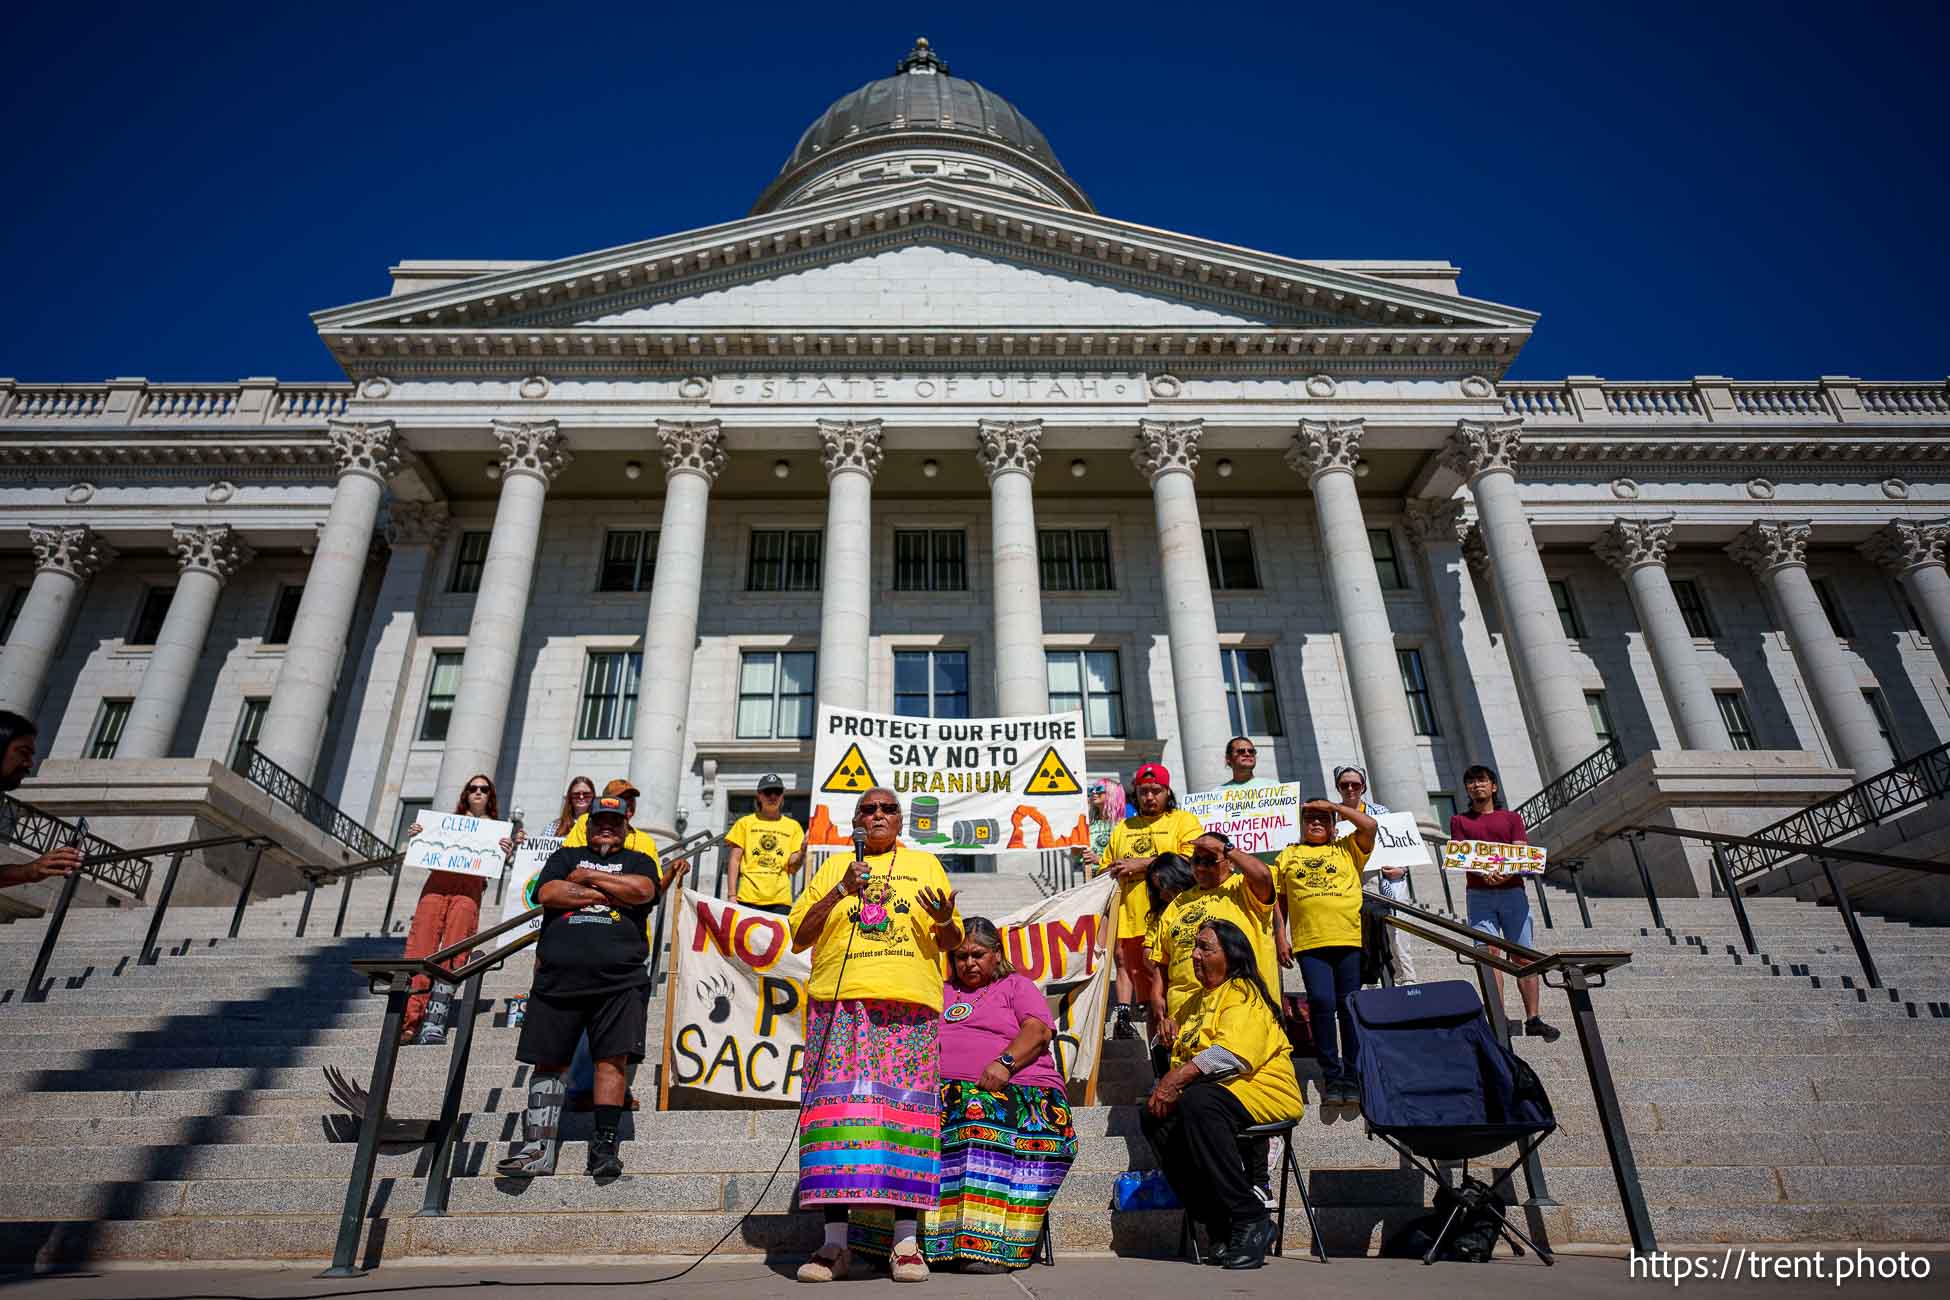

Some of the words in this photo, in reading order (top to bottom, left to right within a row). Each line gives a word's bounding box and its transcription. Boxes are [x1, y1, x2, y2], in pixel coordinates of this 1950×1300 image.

[760, 380, 888, 399] STATE
[914, 380, 959, 399] OF
[988, 380, 1099, 399] UTAH
[829, 715, 932, 741] PROTECT
[939, 723, 983, 741] OUR
[991, 721, 1076, 742] FUTURE
[889, 745, 938, 767] SAY
[946, 746, 979, 768] NO
[988, 746, 1018, 766] TO
[893, 770, 1012, 793] URANIUM
[1184, 793, 1222, 805] DUMPING
[1225, 802, 1256, 812] BURIAL
[1258, 797, 1297, 809] GROUNDS
[441, 815, 480, 833] CLEAN
[1203, 815, 1292, 834] IRONMENTAL
[1447, 842, 1472, 855] DO
[421, 851, 441, 867] AIR
[1445, 857, 1466, 869] BE
[692, 901, 789, 972] NO
